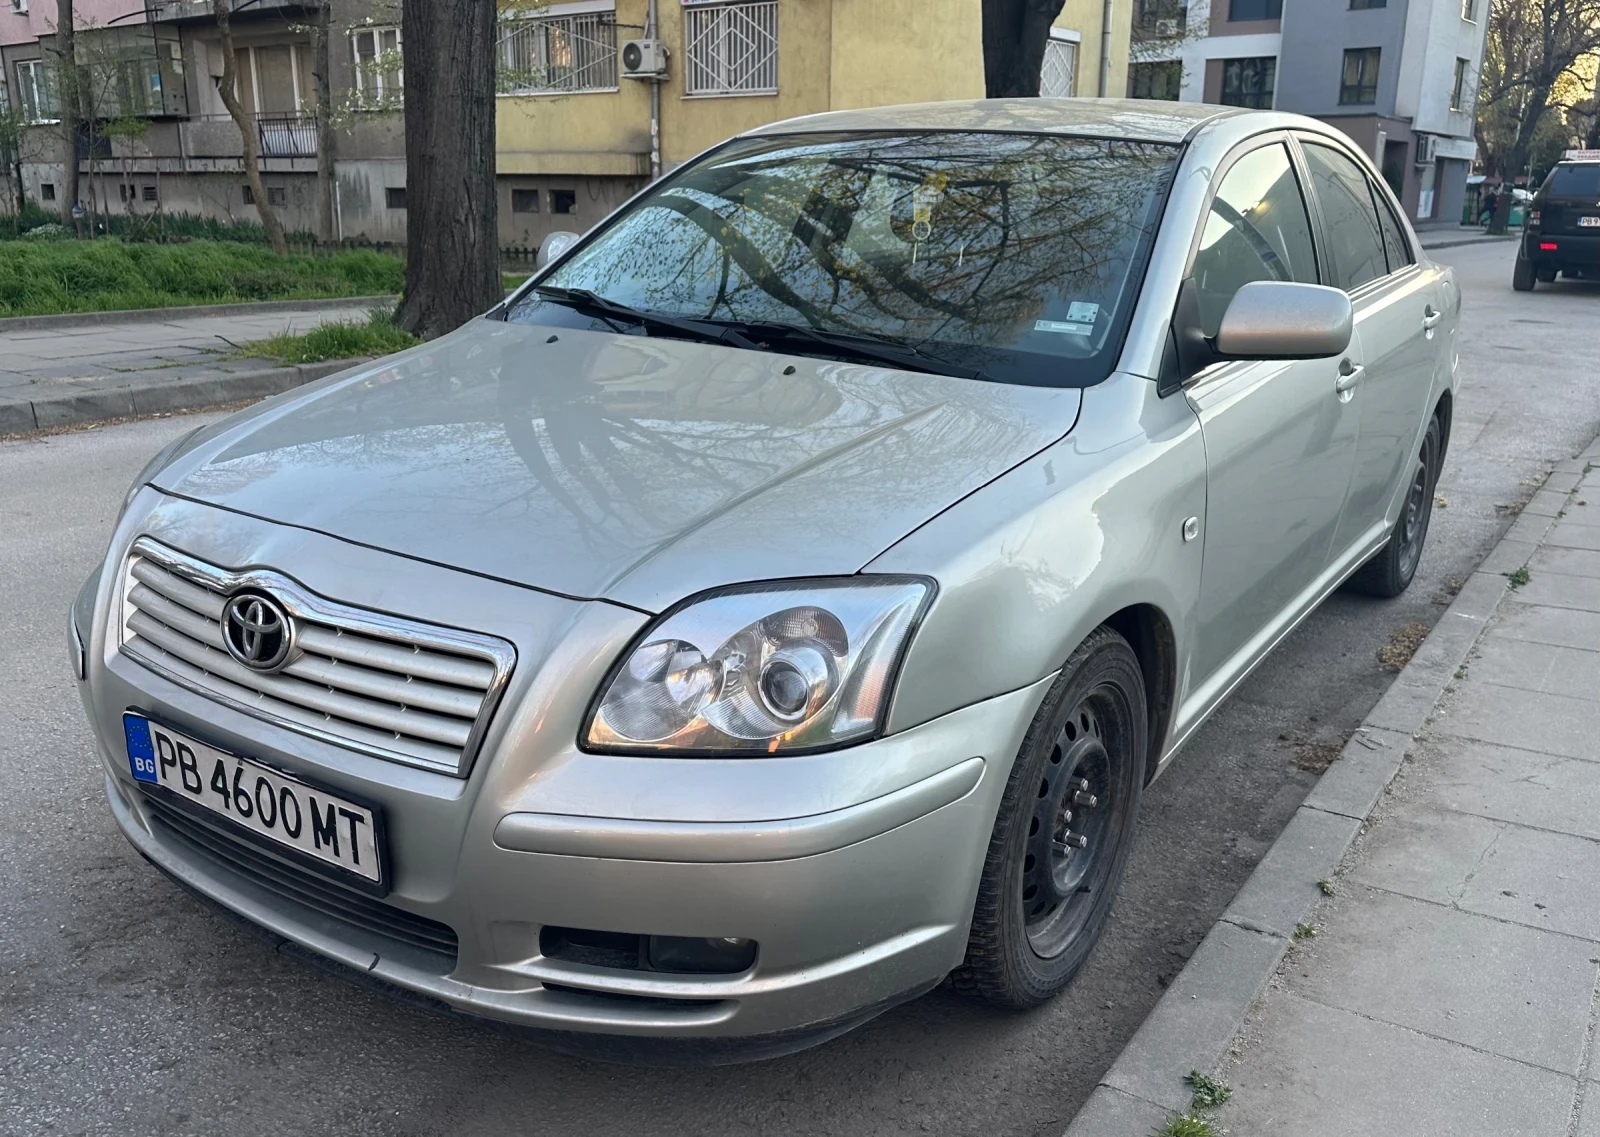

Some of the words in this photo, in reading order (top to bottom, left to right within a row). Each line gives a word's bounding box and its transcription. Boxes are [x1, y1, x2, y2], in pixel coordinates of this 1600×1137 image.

[135, 757, 154, 773] BG
[155, 731, 203, 795] PB
[211, 758, 302, 839] 4600
[310, 796, 365, 865] MT
